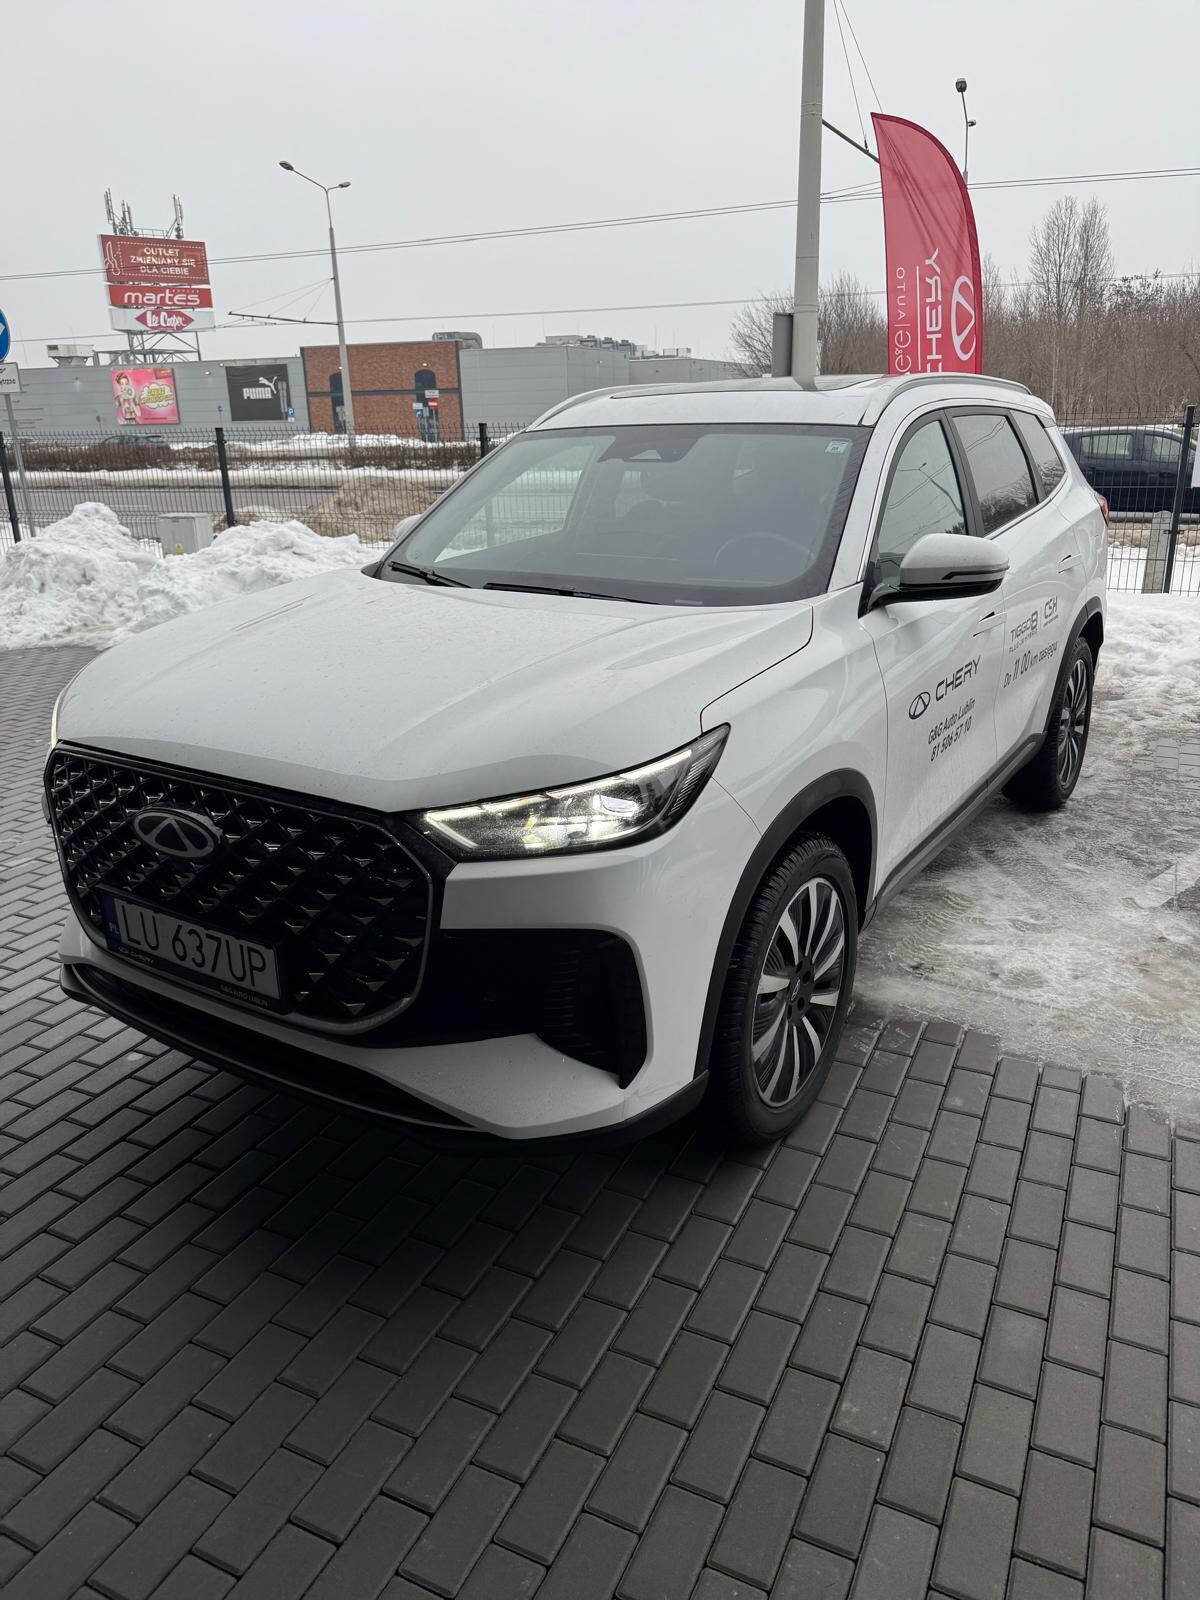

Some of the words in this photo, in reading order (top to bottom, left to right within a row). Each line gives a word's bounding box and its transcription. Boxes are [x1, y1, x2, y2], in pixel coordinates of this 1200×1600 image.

[144, 247, 180, 256] OUTLET
[130, 255, 181, 266] ZMIENIAMY
[181, 258, 196, 268] SIĘ
[140, 266, 159, 274] DLA
[160, 267, 190, 275] CIEBIE
[124, 288, 200, 305] martes
[242, 387, 273, 400] PUMA
[935, 655, 981, 702] CHERY
[929, 722, 943, 744] G&G
[944, 713, 957, 731] Auto
[931, 742, 940, 762] 81
[941, 731, 954, 753] 506
[954, 723, 963, 742] 57
[964, 715, 972, 735] 10
[109, 921, 120, 935] PL
[121, 904, 159, 951] LU
[171, 924, 266, 987] 637UP
